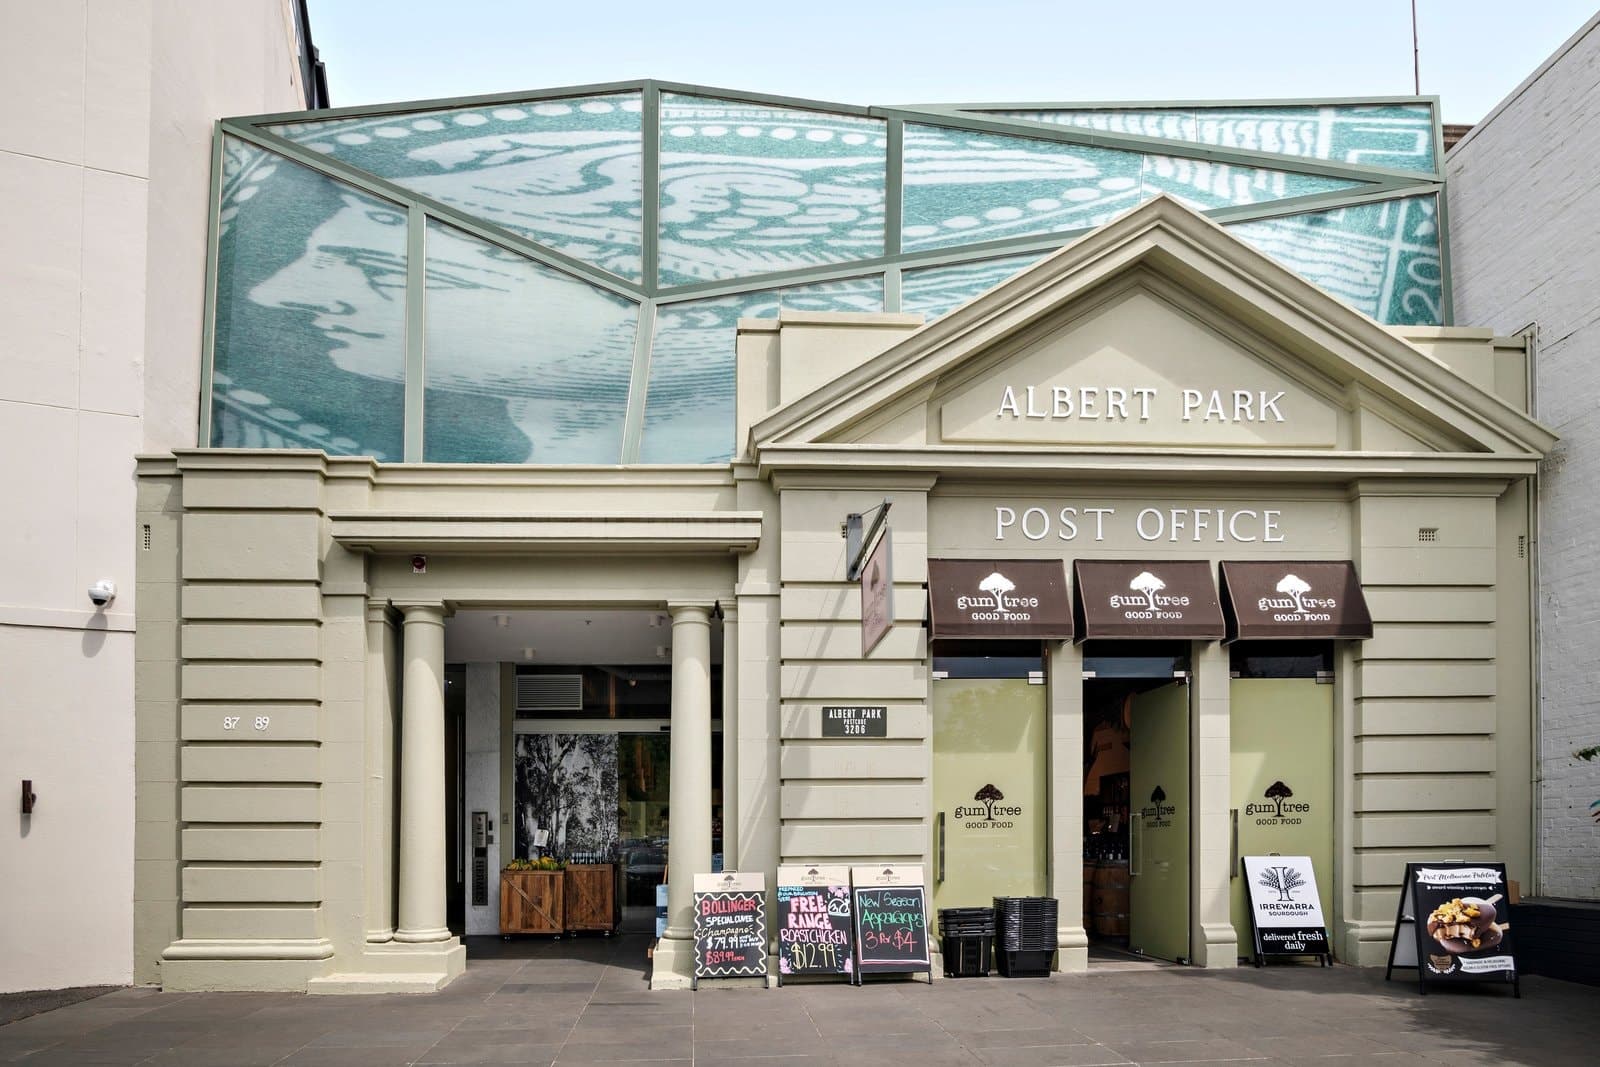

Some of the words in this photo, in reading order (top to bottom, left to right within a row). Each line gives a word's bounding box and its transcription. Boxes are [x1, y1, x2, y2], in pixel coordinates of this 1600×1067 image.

[998, 386, 1157, 420] ALBERT
[1181, 389, 1286, 422] PARK
[995, 507, 1115, 541] POST
[1136, 508, 1285, 542] OFFICE
[957, 595, 996, 609] gum
[1003, 595, 1039, 608] tree
[1110, 594, 1148, 608] gum
[1154, 594, 1190, 606] tree
[1258, 597, 1296, 611] gum
[1301, 596, 1336, 608] tree
[971, 612, 1000, 621] GOOD
[1003, 612, 1031, 621] FOOD
[1125, 611, 1153, 619] GOOD
[1156, 611, 1183, 619] FOOD
[1274, 613, 1301, 622] GOOD
[1303, 613, 1331, 621] FOOD
[828, 708, 857, 719] ALBERT
[861, 708, 882, 719] PARK
[223, 716, 240, 730] 87
[254, 716, 270, 731] 89
[844, 724, 866, 734] 3206
[954, 805, 986, 819] gum
[993, 805, 1022, 816] tree
[1141, 807, 1157, 820] gum
[1159, 805, 1176, 816] tree
[1245, 803, 1275, 816] gum
[1282, 802, 1310, 812] tree
[790, 895, 827, 913] FREE
[859, 891, 881, 908] New
[883, 891, 920, 908] Season
[702, 899, 756, 916] BOLLINGER
[705, 915, 734, 927] SPECIAL
[787, 912, 832, 930] RANGE
[861, 908, 924, 932] Asparagus
[701, 926, 750, 938] Champagne
[780, 928, 810, 942] ROAST
[809, 929, 848, 945] CHICKEN
[1263, 932, 1296, 941] delivered
[1297, 930, 1323, 941] fresh
[706, 936, 738, 950] $79.99
[865, 931, 879, 950] 3
[879, 932, 891, 945] for
[892, 929, 918, 953] $4
[1284, 940, 1306, 951] daily
[705, 951, 735, 966] $89.99
[790, 942, 837, 970] $12.99
